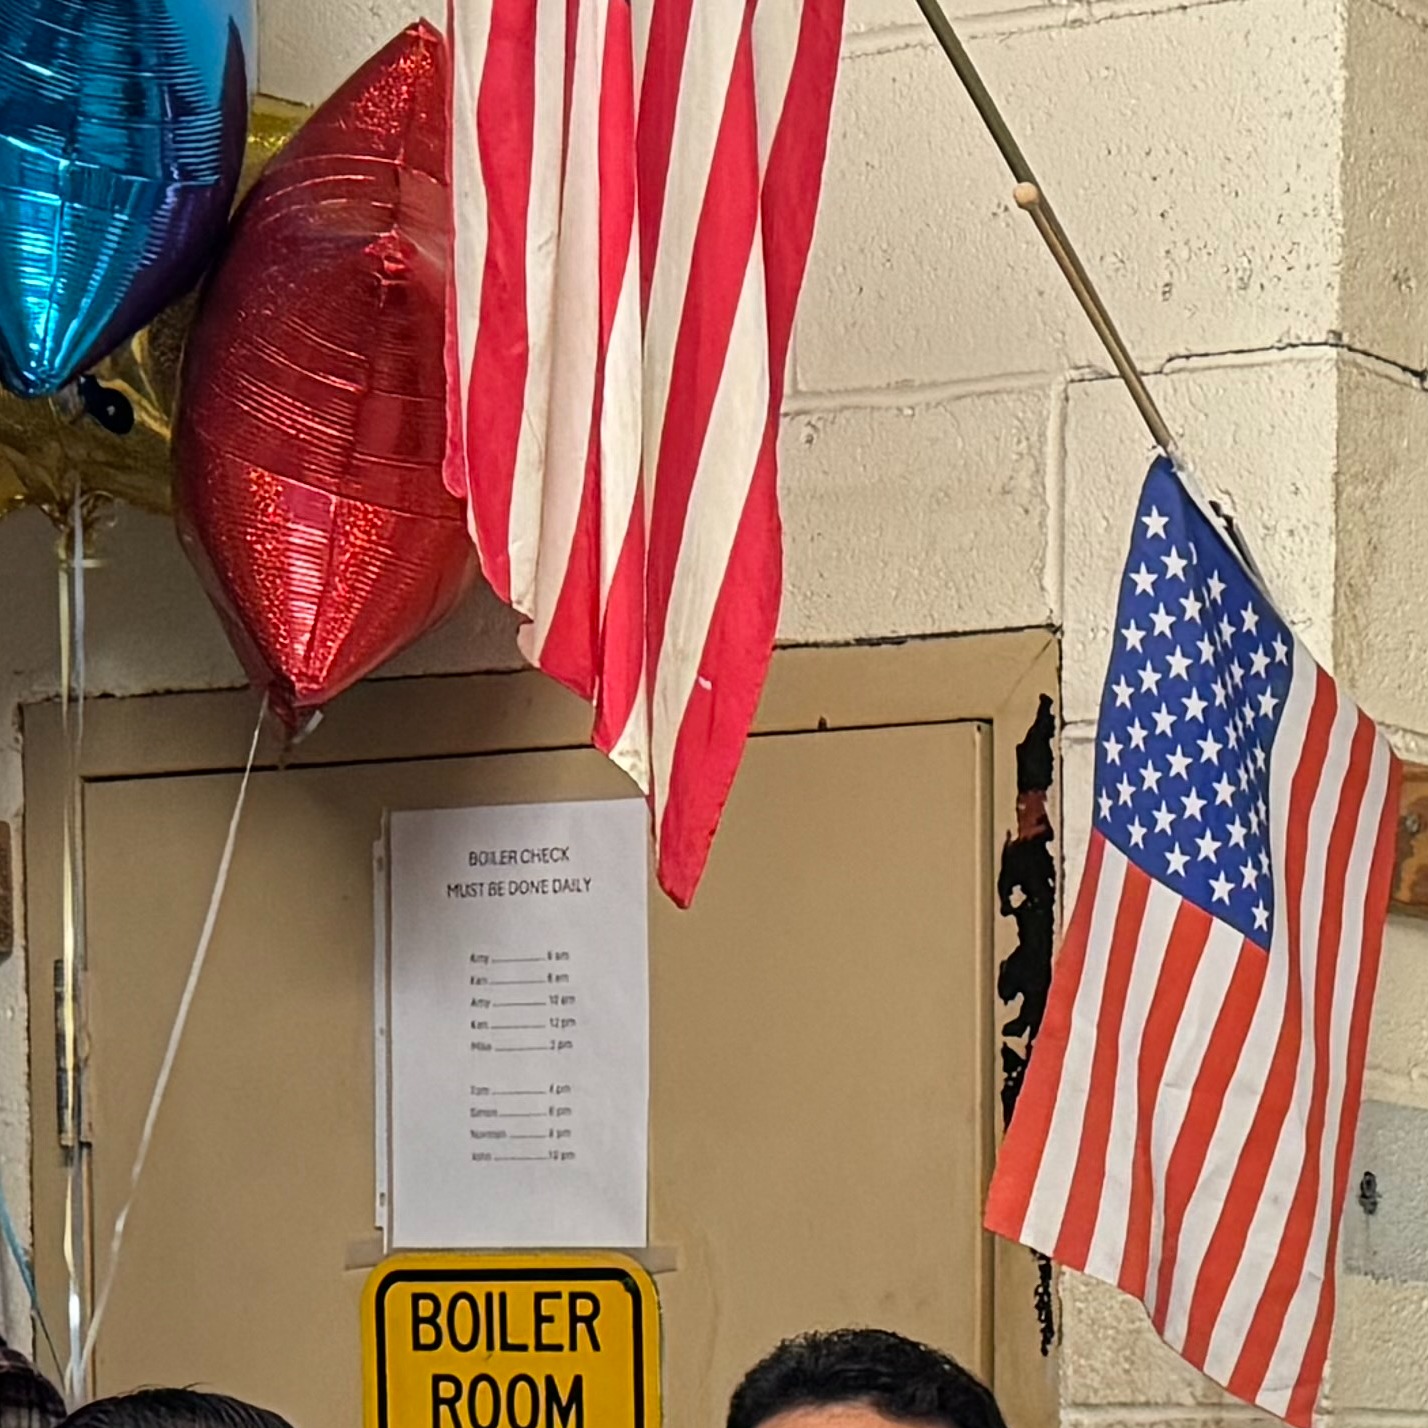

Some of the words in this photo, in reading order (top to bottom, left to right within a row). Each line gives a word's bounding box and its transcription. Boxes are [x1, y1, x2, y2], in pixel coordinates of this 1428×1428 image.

[469, 850, 518, 867] BOILER
[520, 846, 570, 865] CHECK
[447, 882, 485, 899] MUST
[488, 881, 506, 897] BE
[508, 879, 549, 896] DONE
[552, 877, 592, 894] DAILY
[561, 1018, 576, 1029] pm
[557, 1040, 573, 1051] pm
[556, 1085, 571, 1095] pm
[557, 1107, 572, 1118] pm
[557, 1129, 572, 1140] pm
[561, 1151, 576, 1161] pm
[411, 1291, 601, 1353] BOILER
